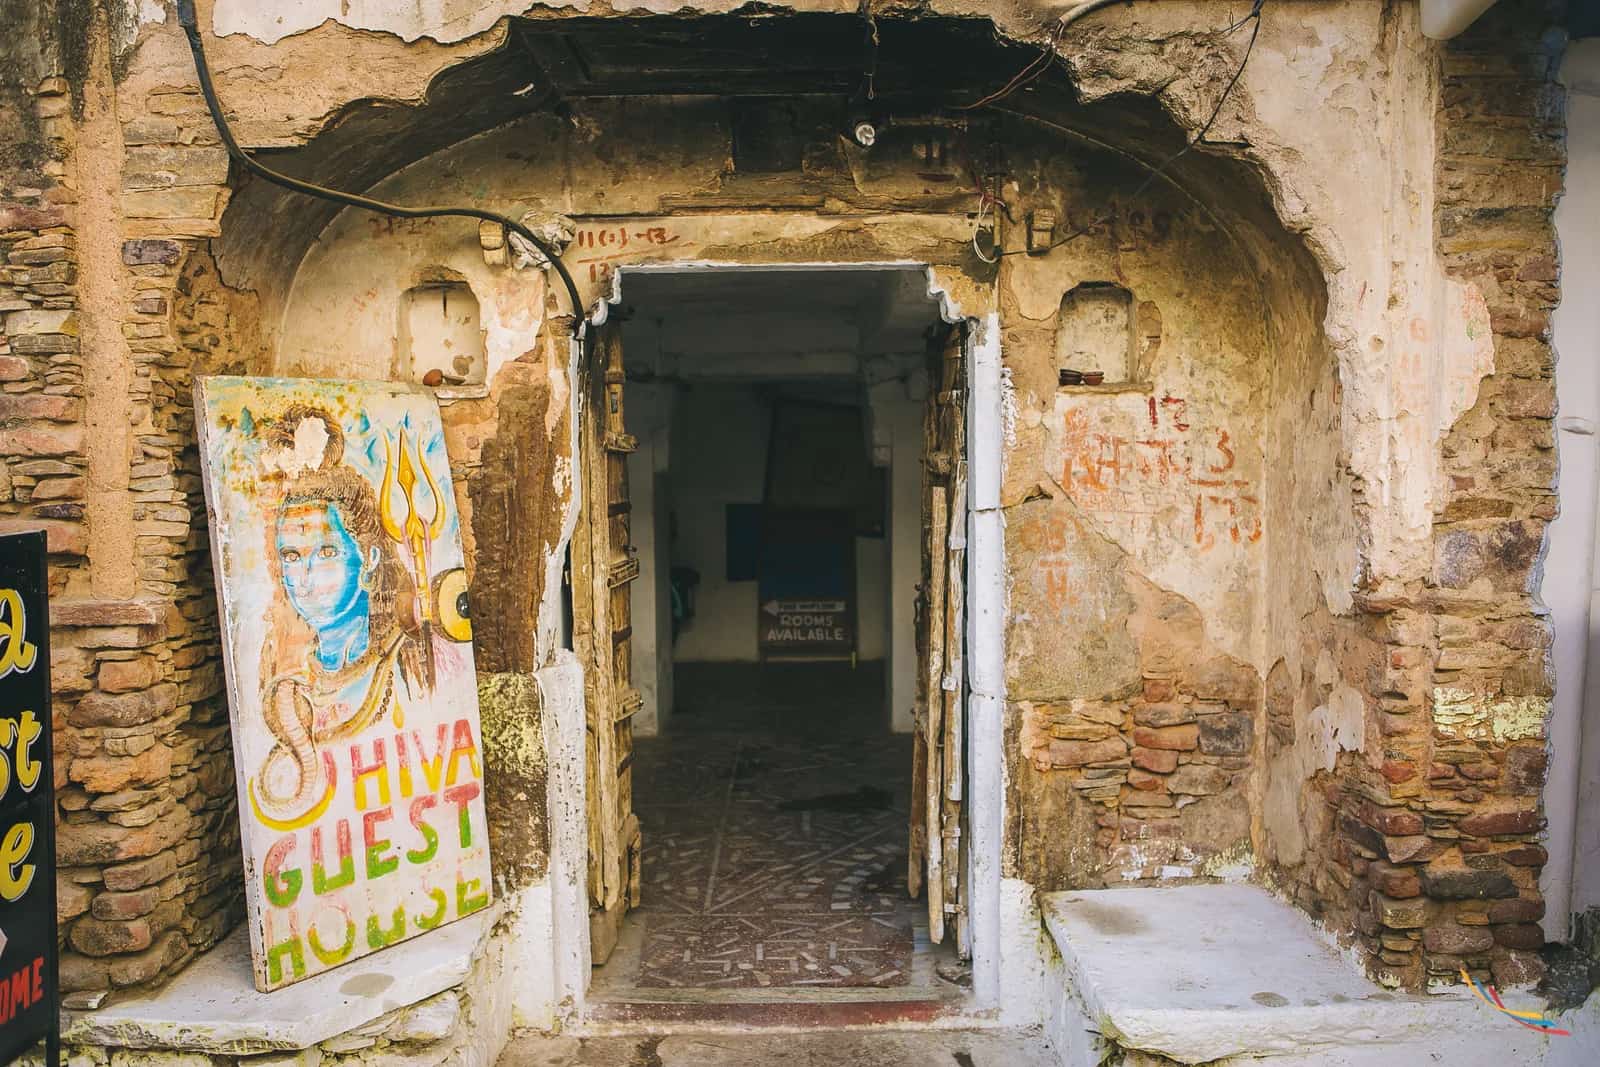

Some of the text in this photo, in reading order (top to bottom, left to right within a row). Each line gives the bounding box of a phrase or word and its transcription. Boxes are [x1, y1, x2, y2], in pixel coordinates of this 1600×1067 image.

[767, 627, 844, 641] AVAILABLE
[780, 614, 833, 626] ROOMS
[262, 782, 481, 908] GUEST
[266, 849, 489, 983] HOUSE
